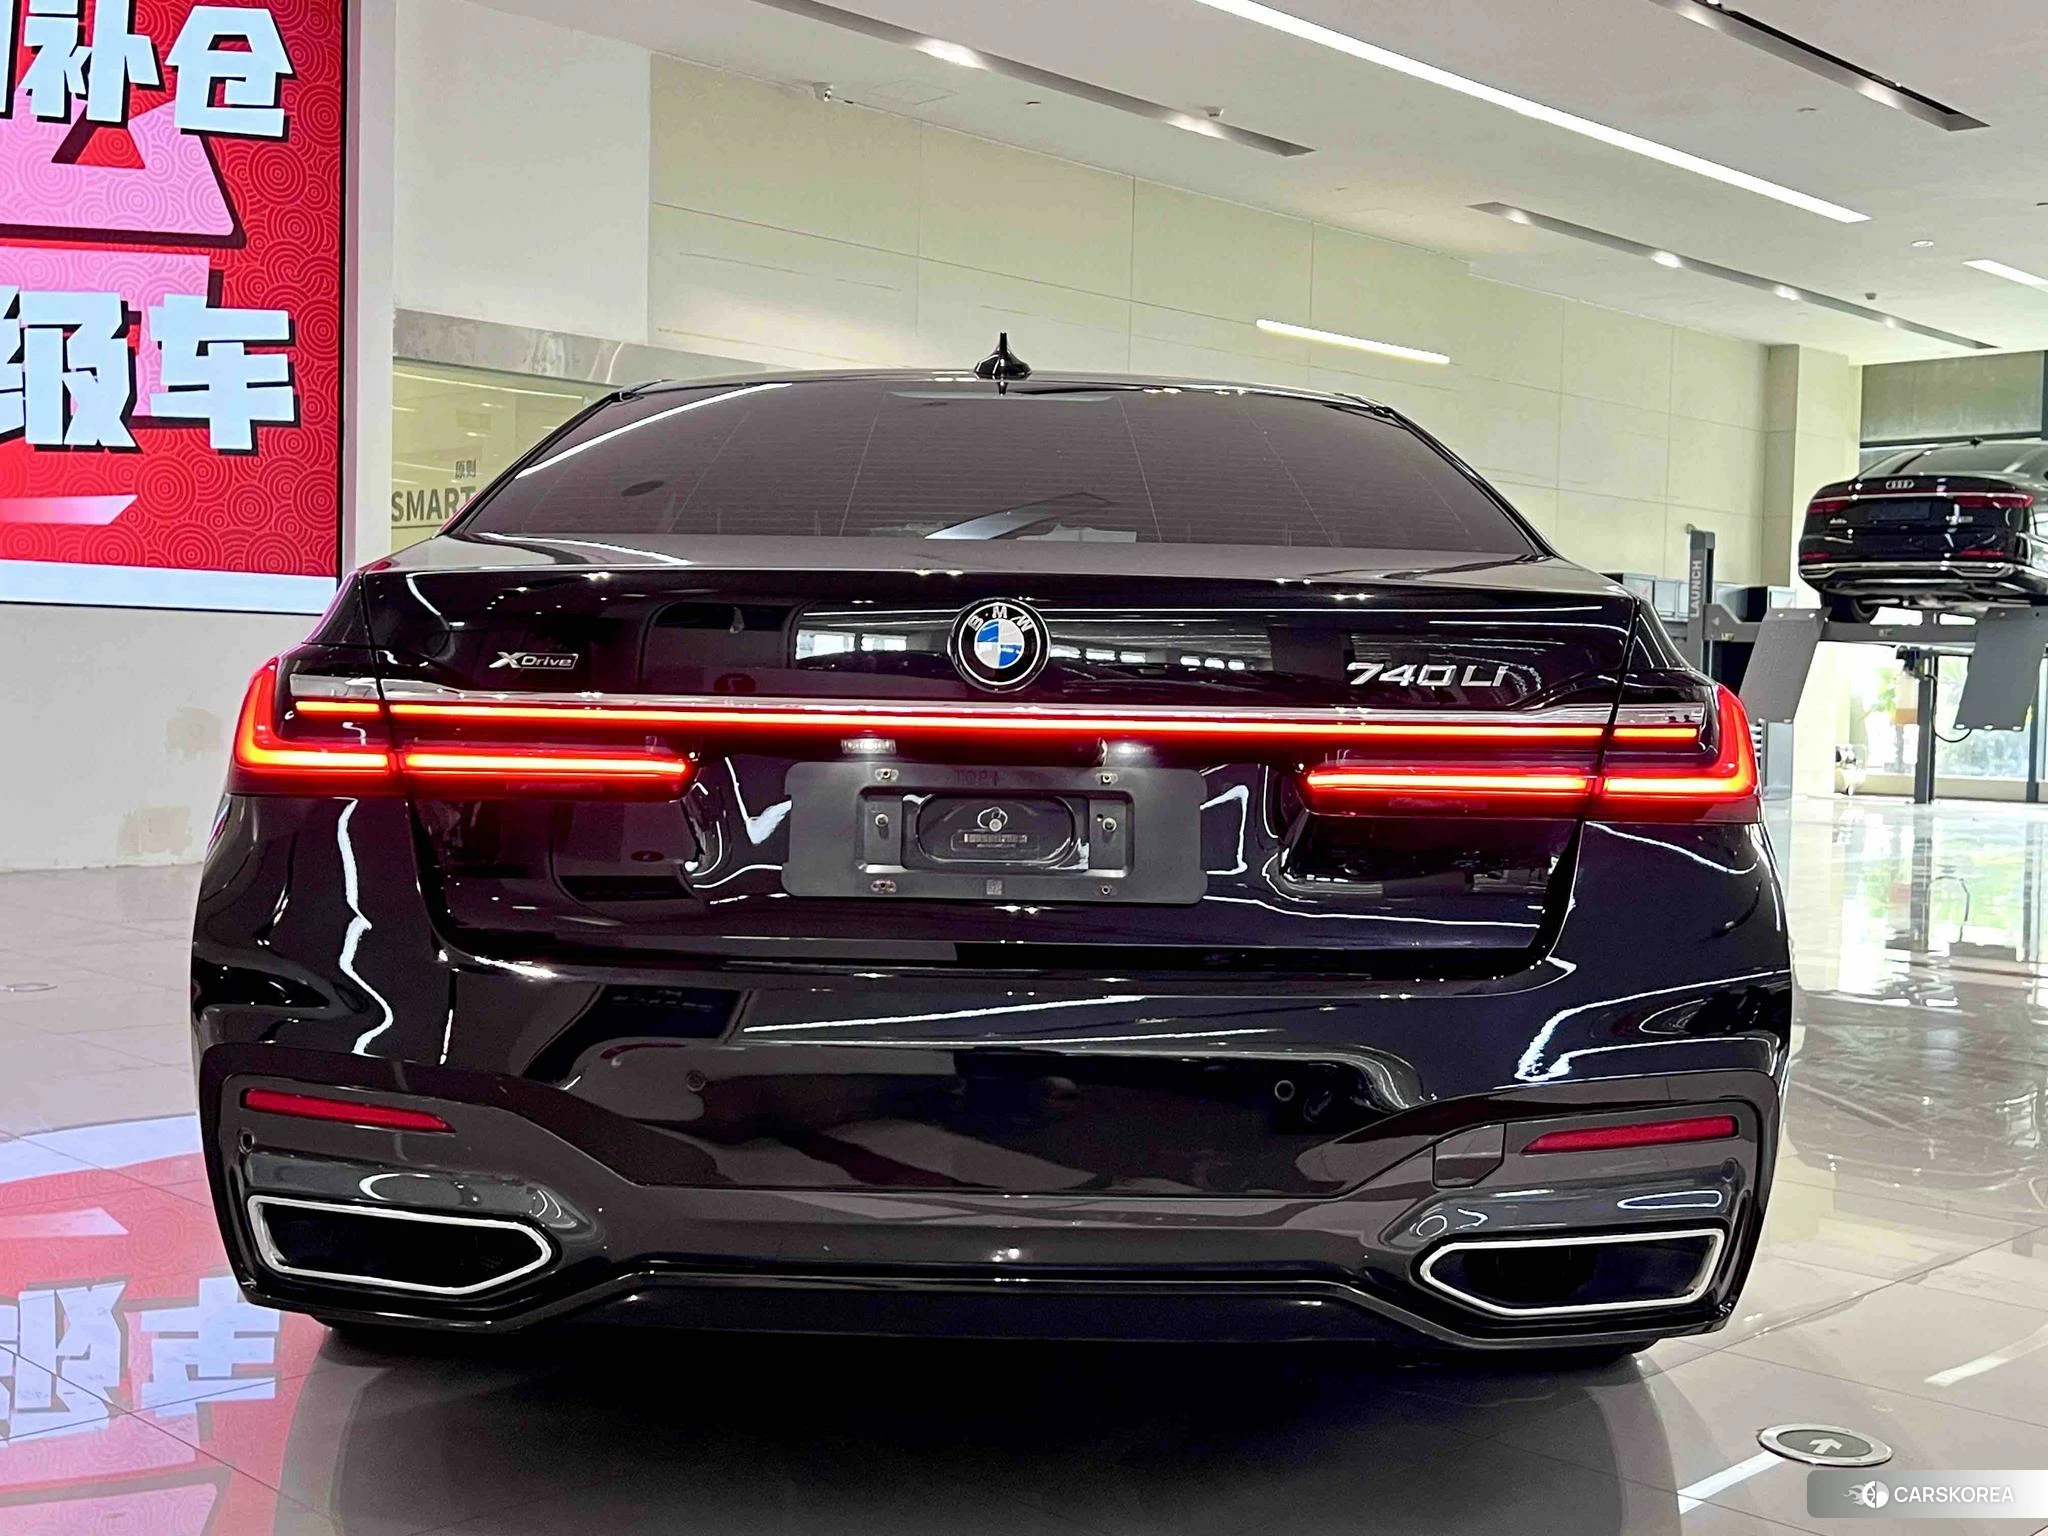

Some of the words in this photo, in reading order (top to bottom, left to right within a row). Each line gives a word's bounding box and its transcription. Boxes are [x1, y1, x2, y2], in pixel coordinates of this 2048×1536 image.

[0, 0, 294, 137] 补仓
[967, 604, 1034, 632] BMW
[1690, 560, 1703, 618] LAUNCH
